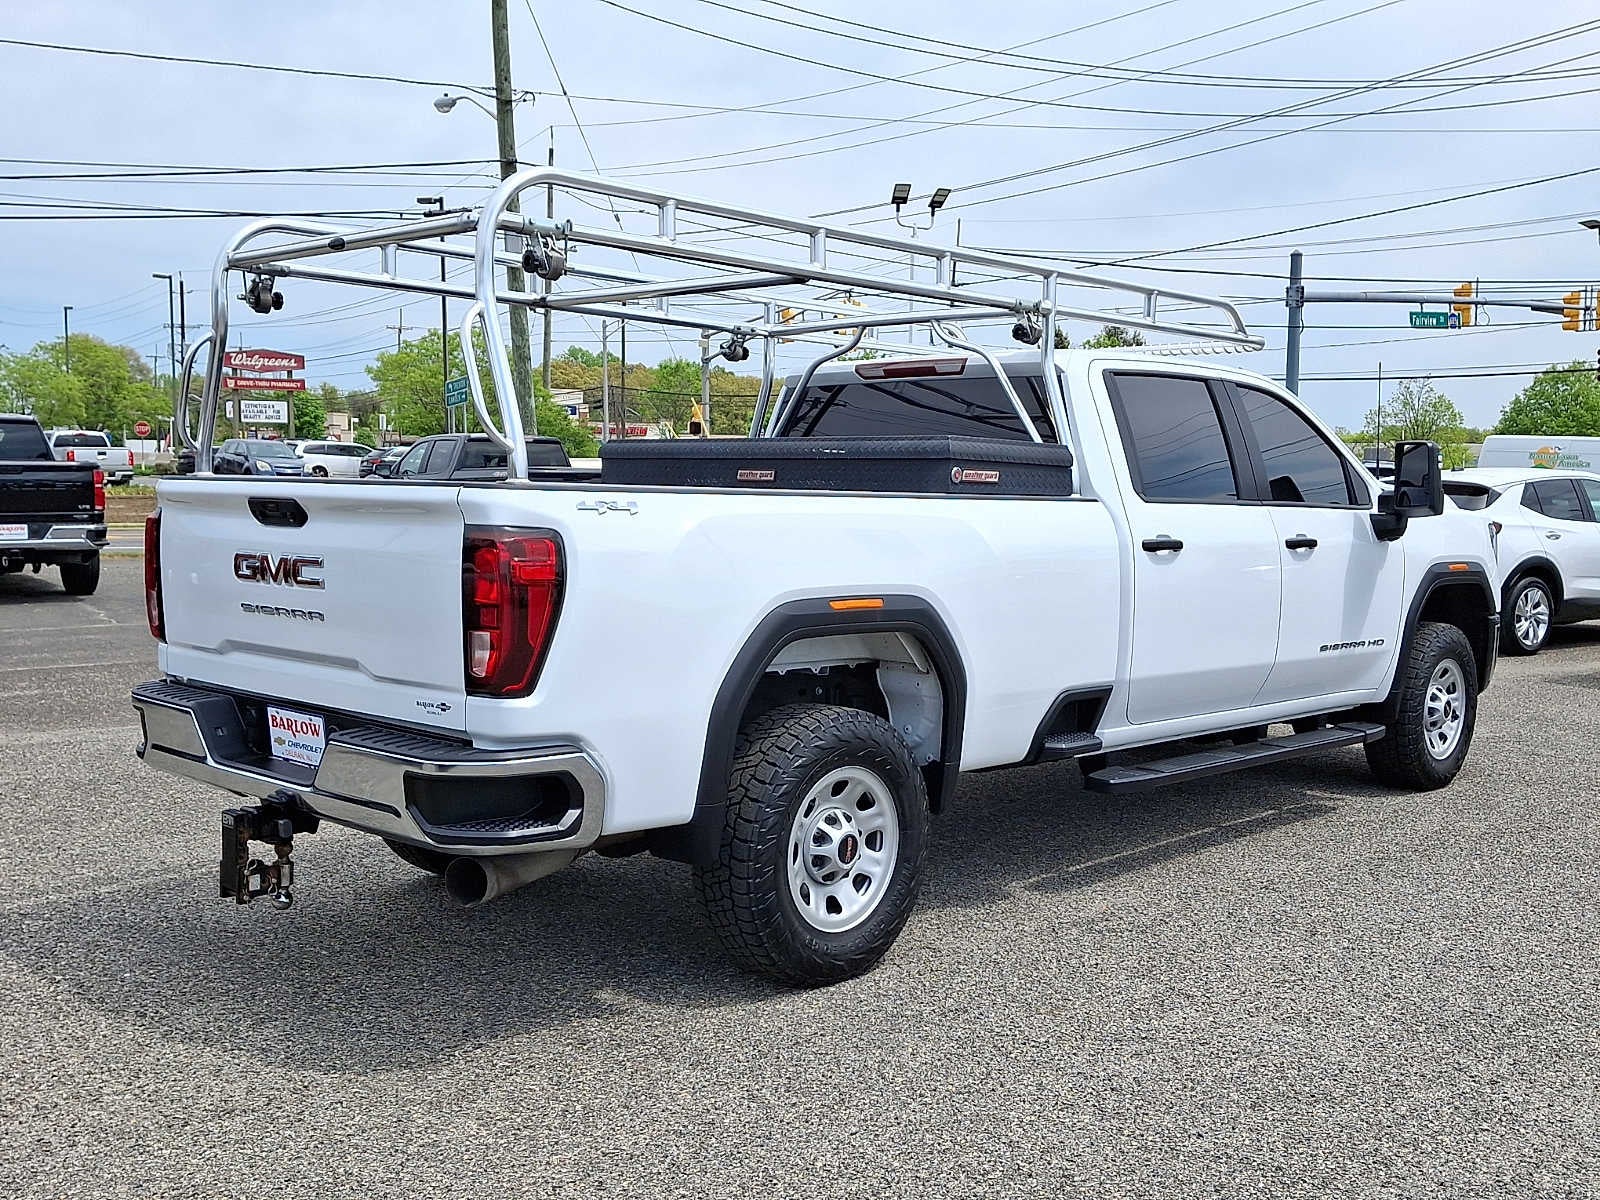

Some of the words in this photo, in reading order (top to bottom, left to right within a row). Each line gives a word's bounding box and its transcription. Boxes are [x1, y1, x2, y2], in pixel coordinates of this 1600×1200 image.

[1412, 315, 1437, 326] Fairview
[229, 352, 298, 369] Walgreens
[237, 380, 270, 388] DRIVE-THRU
[270, 381, 301, 389] PHARMACY
[233, 552, 325, 592] GMC
[240, 602, 325, 622] SIERRA
[1319, 640, 1366, 653] SIERRA
[1367, 639, 1385, 647] HD
[270, 714, 321, 739] BARLOW
[287, 740, 323, 754] CHEVROLET
